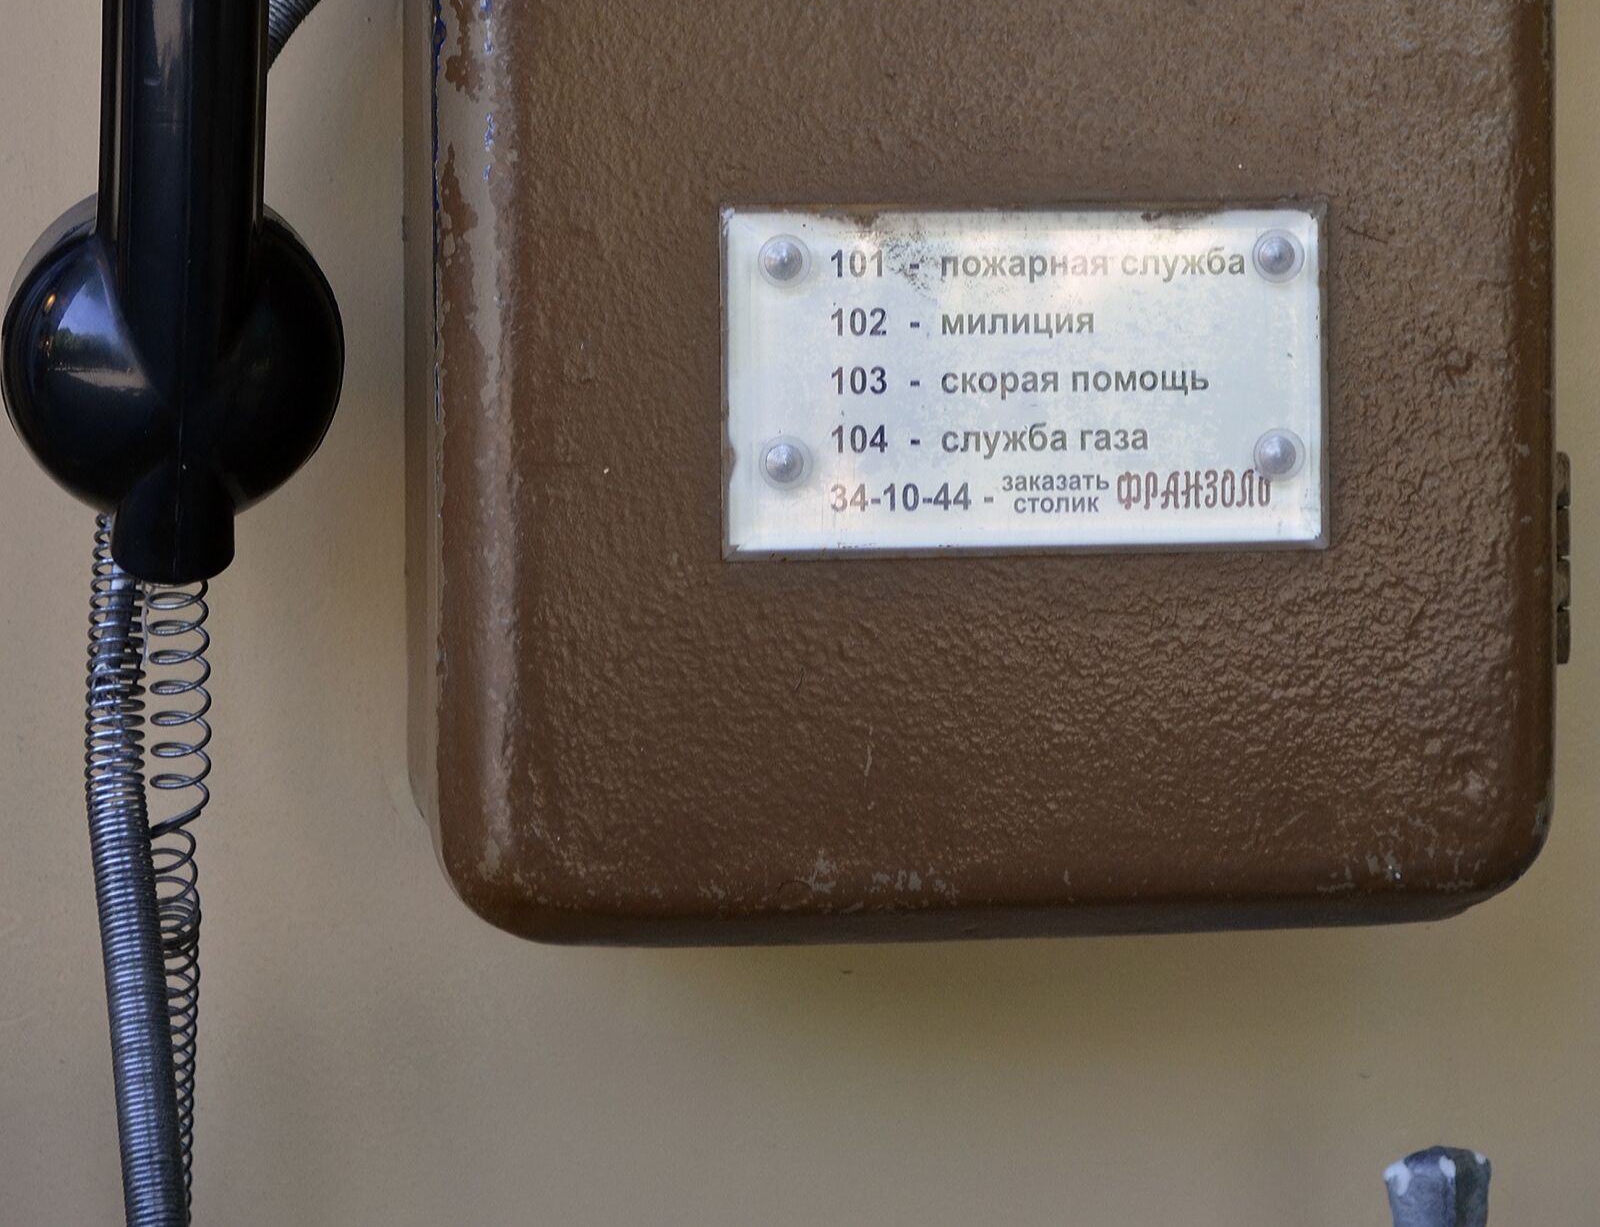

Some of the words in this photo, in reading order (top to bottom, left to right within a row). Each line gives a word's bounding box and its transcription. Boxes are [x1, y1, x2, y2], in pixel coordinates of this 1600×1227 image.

[830, 249, 884, 278] 101
[941, 255, 1110, 283] пожарная
[1121, 247, 1246, 282] служба
[830, 307, 887, 336] 102
[941, 311, 1095, 339] милиция
[830, 366, 888, 394] 103
[941, 371, 1059, 400] скорая
[1072, 368, 1209, 394] помощь
[830, 425, 888, 454] 104
[941, 425, 1068, 459] служба
[1080, 429, 1149, 451] газа
[830, 482, 970, 513] 34-10-44
[1002, 474, 1110, 492] заказать
[1013, 494, 1100, 514] столик
